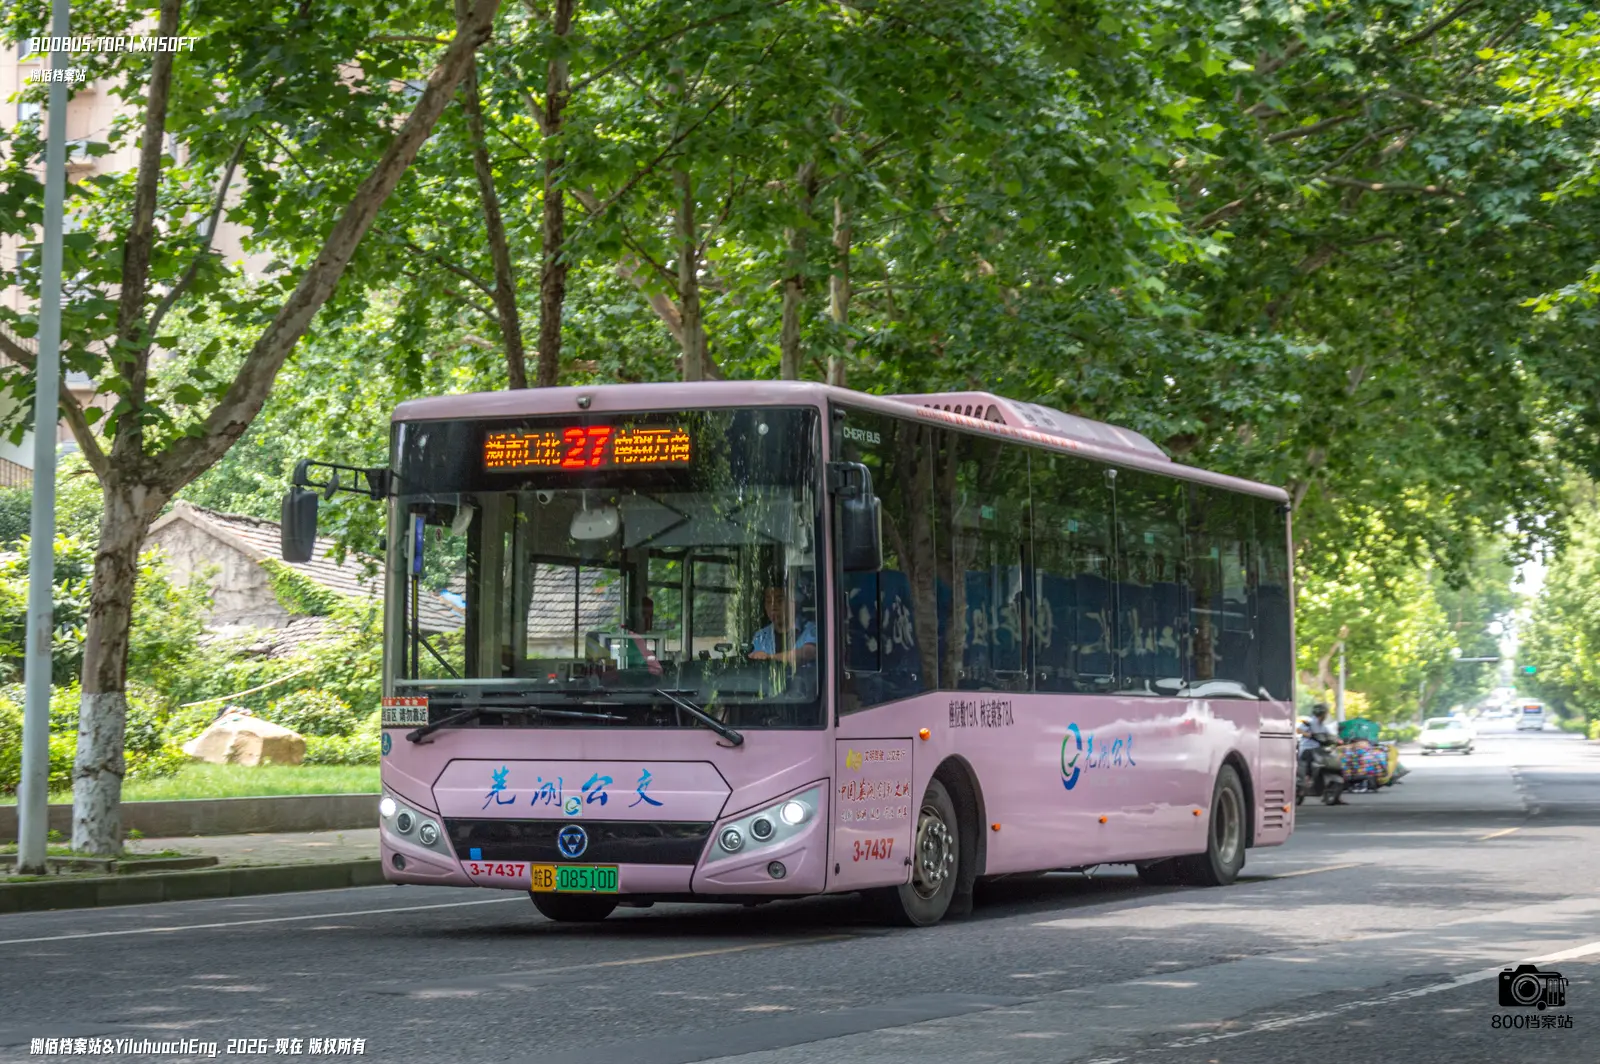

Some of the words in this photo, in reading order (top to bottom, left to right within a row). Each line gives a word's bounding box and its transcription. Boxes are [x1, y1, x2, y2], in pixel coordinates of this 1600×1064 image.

[843, 426, 865, 441] CHERY
[866, 431, 881, 444] BUS
[562, 426, 612, 468] 27
[399, 708, 427, 722] 请勿靠近
[949, 700, 979, 728] 座位数19人
[980, 699, 1015, 728] 核定载客78人
[482, 765, 664, 810] 芜湖公交
[853, 839, 894, 862] 3-7437
[470, 862, 526, 878] 3-7437
[560, 869, 617, 892] 08510D
